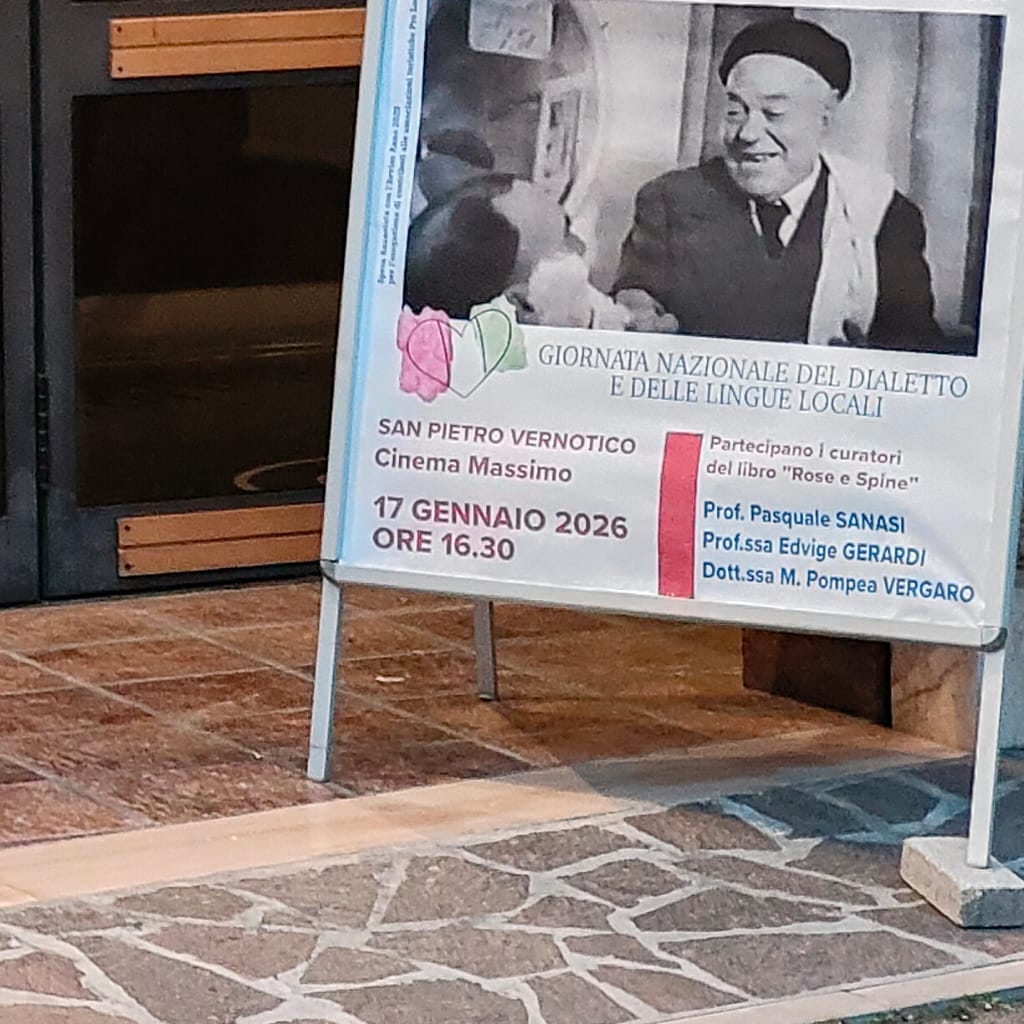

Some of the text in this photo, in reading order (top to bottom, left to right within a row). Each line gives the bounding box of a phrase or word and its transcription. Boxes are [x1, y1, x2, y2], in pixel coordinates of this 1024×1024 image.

[538, 343, 968, 398] GIORNATA NAZIONALE DEL DIALETTO
[610, 376, 884, 418] E DELLE LINGUE LOCALI
[379, 419, 636, 455] SAN PIETRO VERNOTICO
[710, 437, 812, 463] Partecipano
[830, 446, 901, 466] curatori
[375, 448, 572, 483] Cinema Massimo
[706, 459, 919, 494] del libro "Rose e Spine"
[374, 496, 628, 539] 17 GENNAIO 2026
[704, 500, 905, 534] Prof. Pasquale SANASI
[373, 527, 515, 561] ORE 16.30
[703, 531, 926, 567] Prof.ssa Edvige GERARDI
[702, 561, 975, 604] Dott.ssa M. Pompea VERGARO
